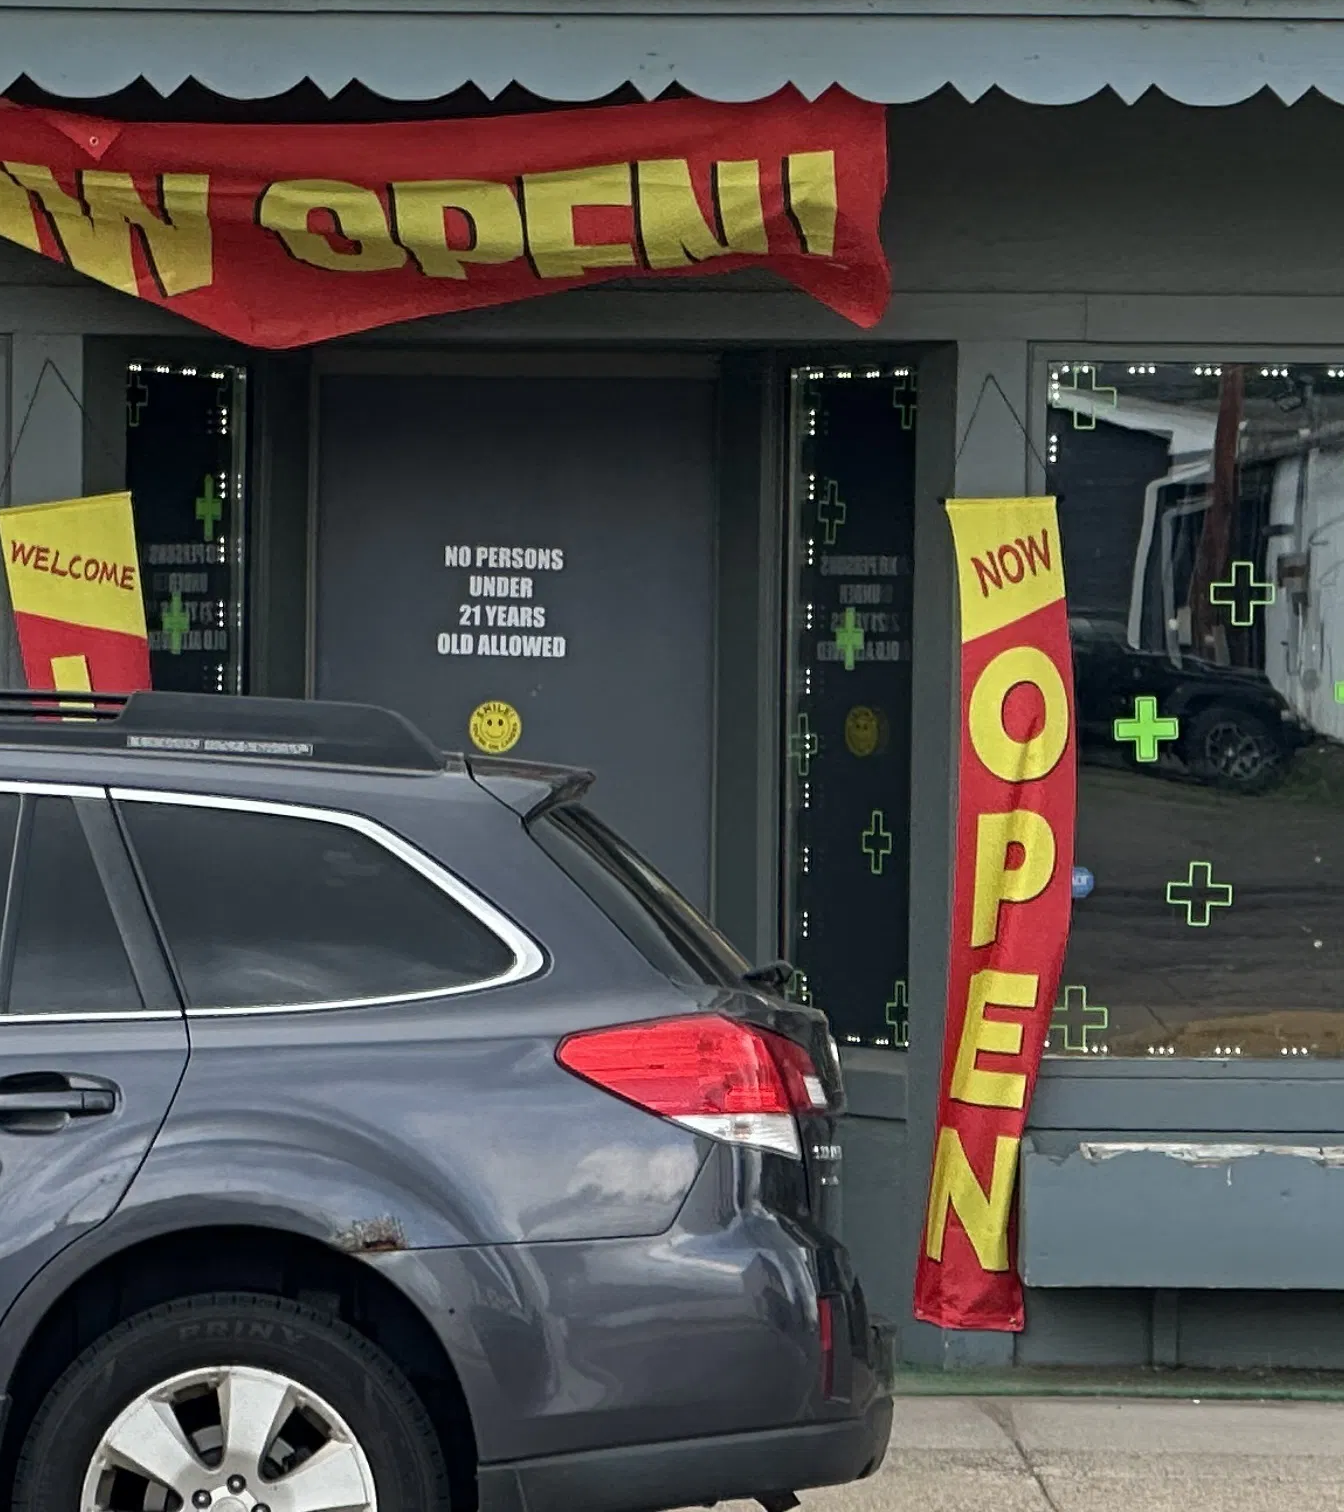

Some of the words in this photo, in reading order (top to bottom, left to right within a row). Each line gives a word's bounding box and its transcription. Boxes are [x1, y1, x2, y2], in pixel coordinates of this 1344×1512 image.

[256, 150, 838, 280] OPEN!
[11, 539, 136, 591] WELCOME
[444, 545, 472, 568] NO
[475, 546, 564, 570] PERSONS
[970, 528, 1051, 599] NOW
[469, 575, 533, 599] UNDER
[459, 604, 481, 627] 21
[485, 605, 546, 628] YEARS
[437, 632, 474, 656] OLD
[477, 634, 566, 658] ALLOWED
[926, 645, 1069, 1273] OPEN
